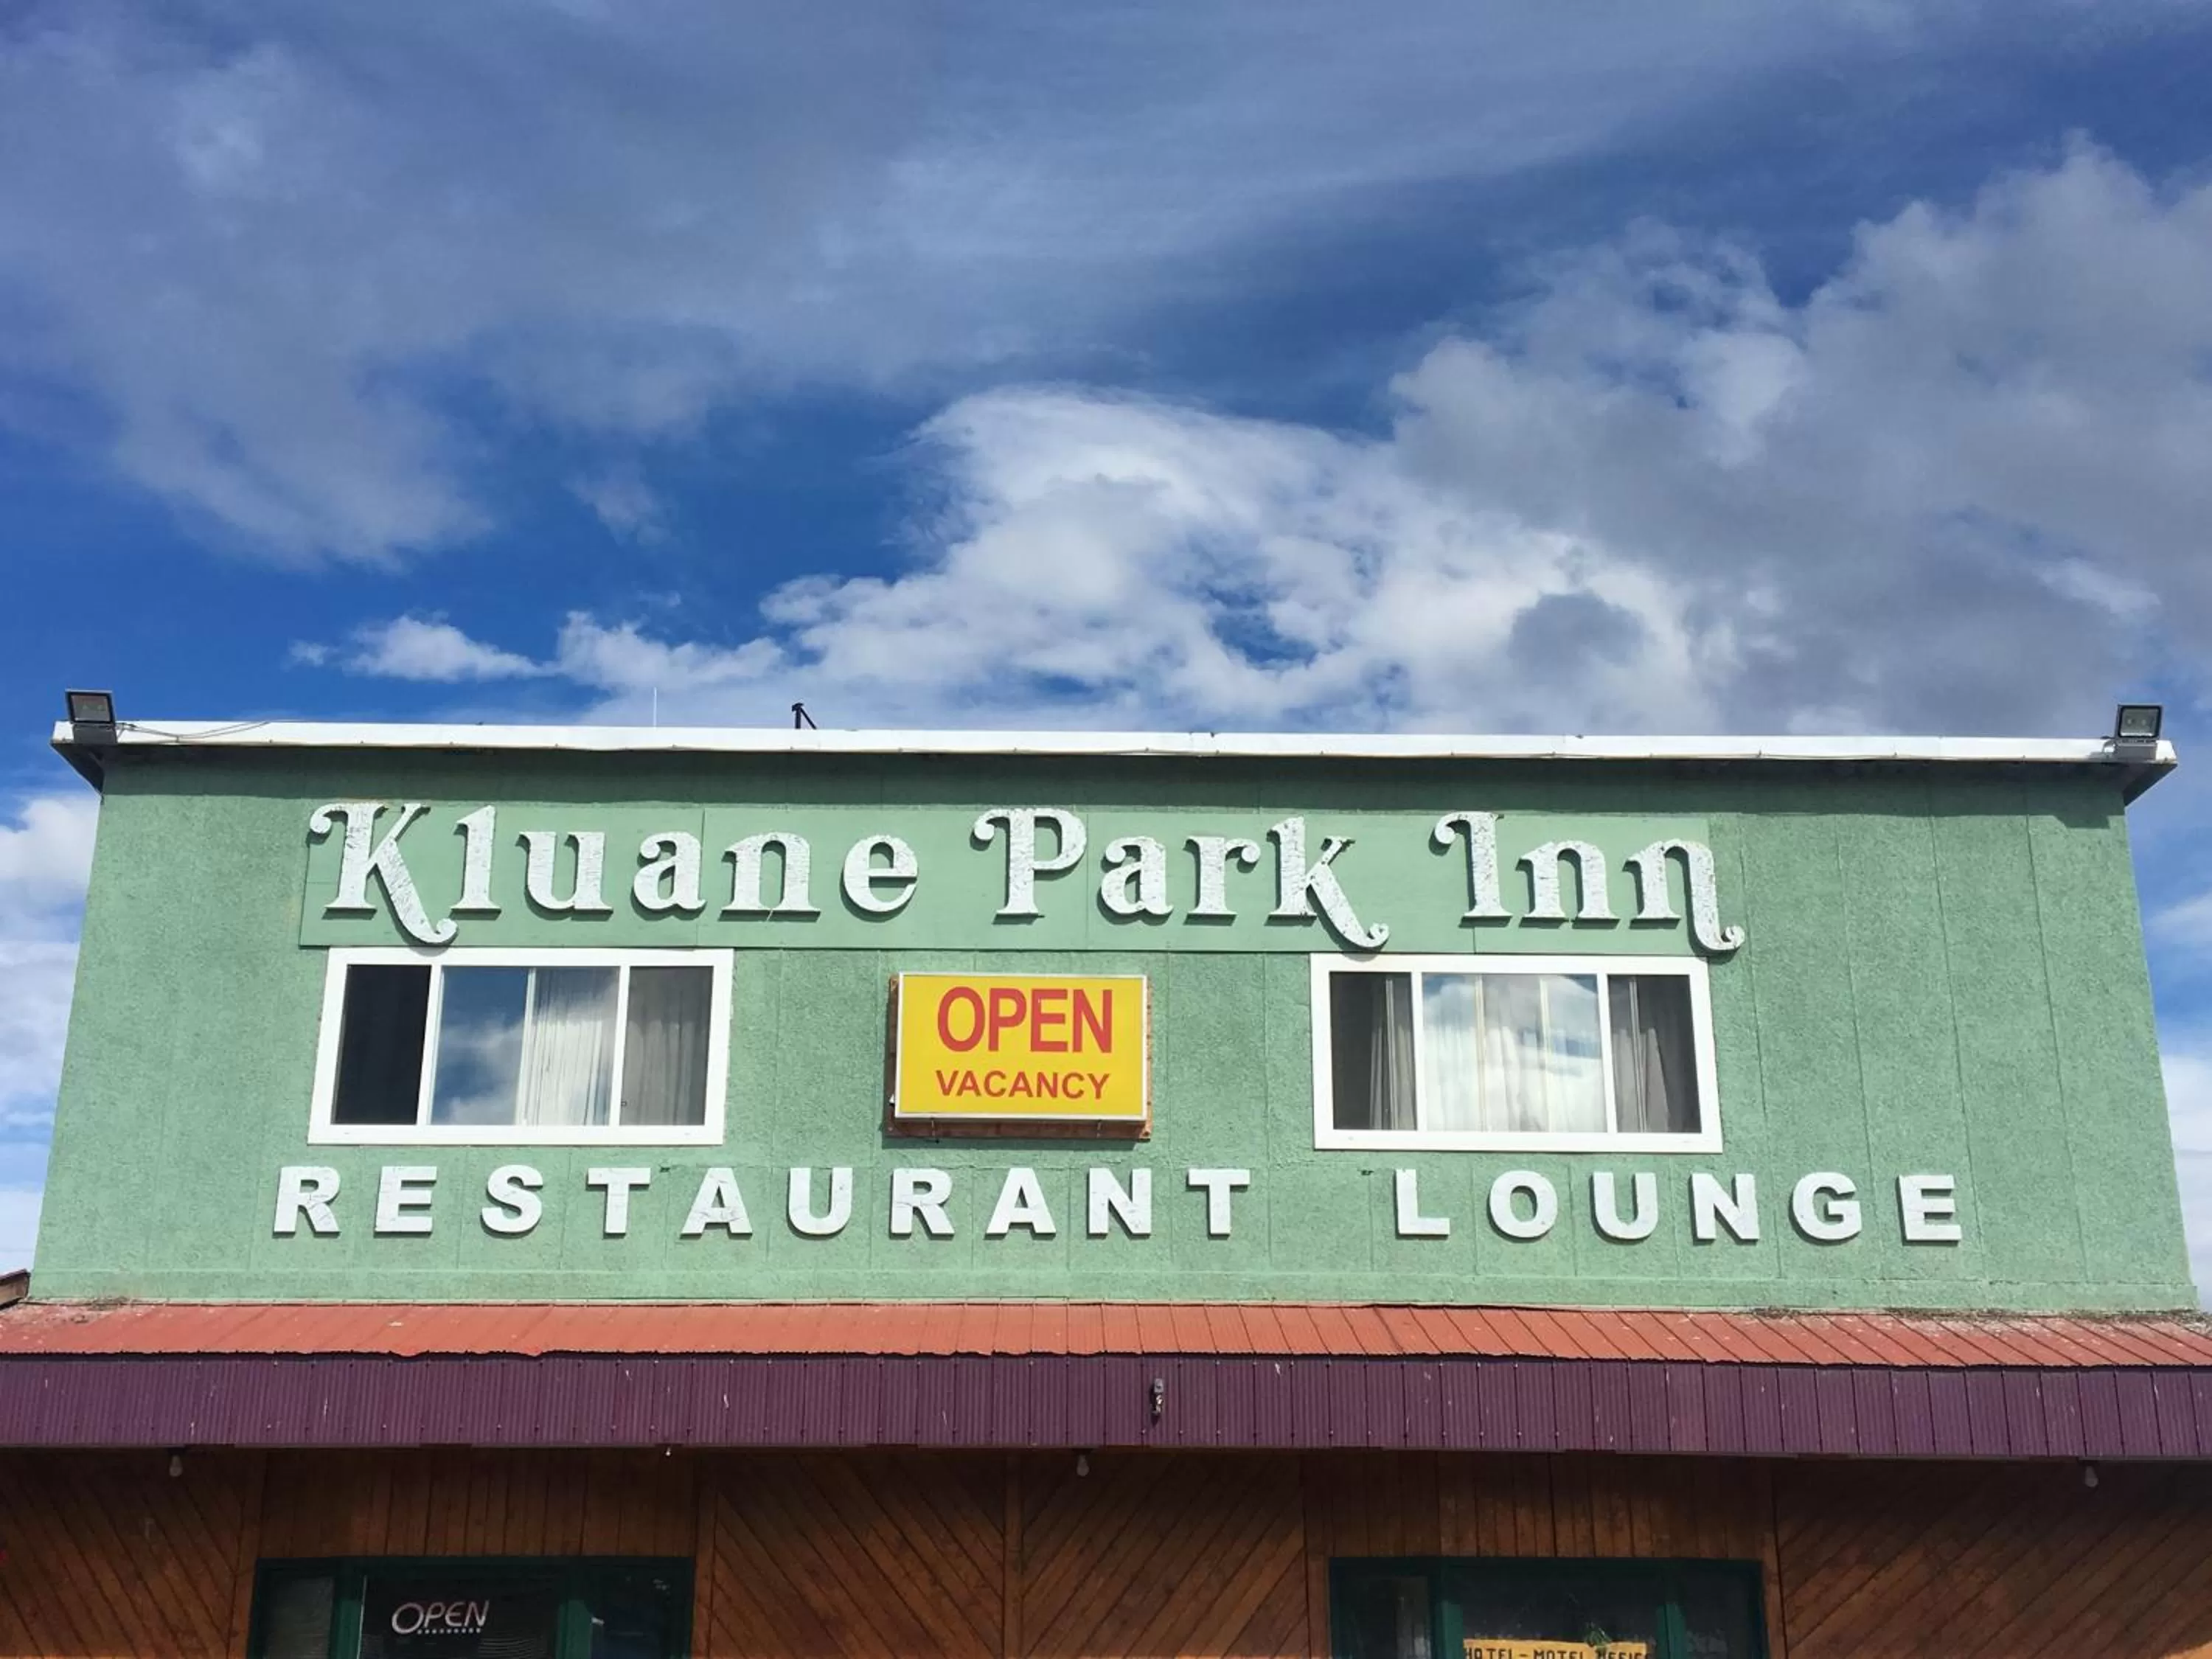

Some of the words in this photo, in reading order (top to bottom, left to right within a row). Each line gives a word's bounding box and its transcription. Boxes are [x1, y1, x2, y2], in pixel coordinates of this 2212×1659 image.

[309, 801, 919, 945] Kluane
[973, 807, 1390, 949] Park
[1431, 810, 1745, 952] Inn
[937, 987, 1113, 1053] OPEN
[936, 1070, 1110, 1099] VACANCY
[272, 1164, 1251, 1237] RESTAURANT
[1394, 1168, 1962, 1242] LOUNGE
[392, 1599, 490, 1635] OPEN
